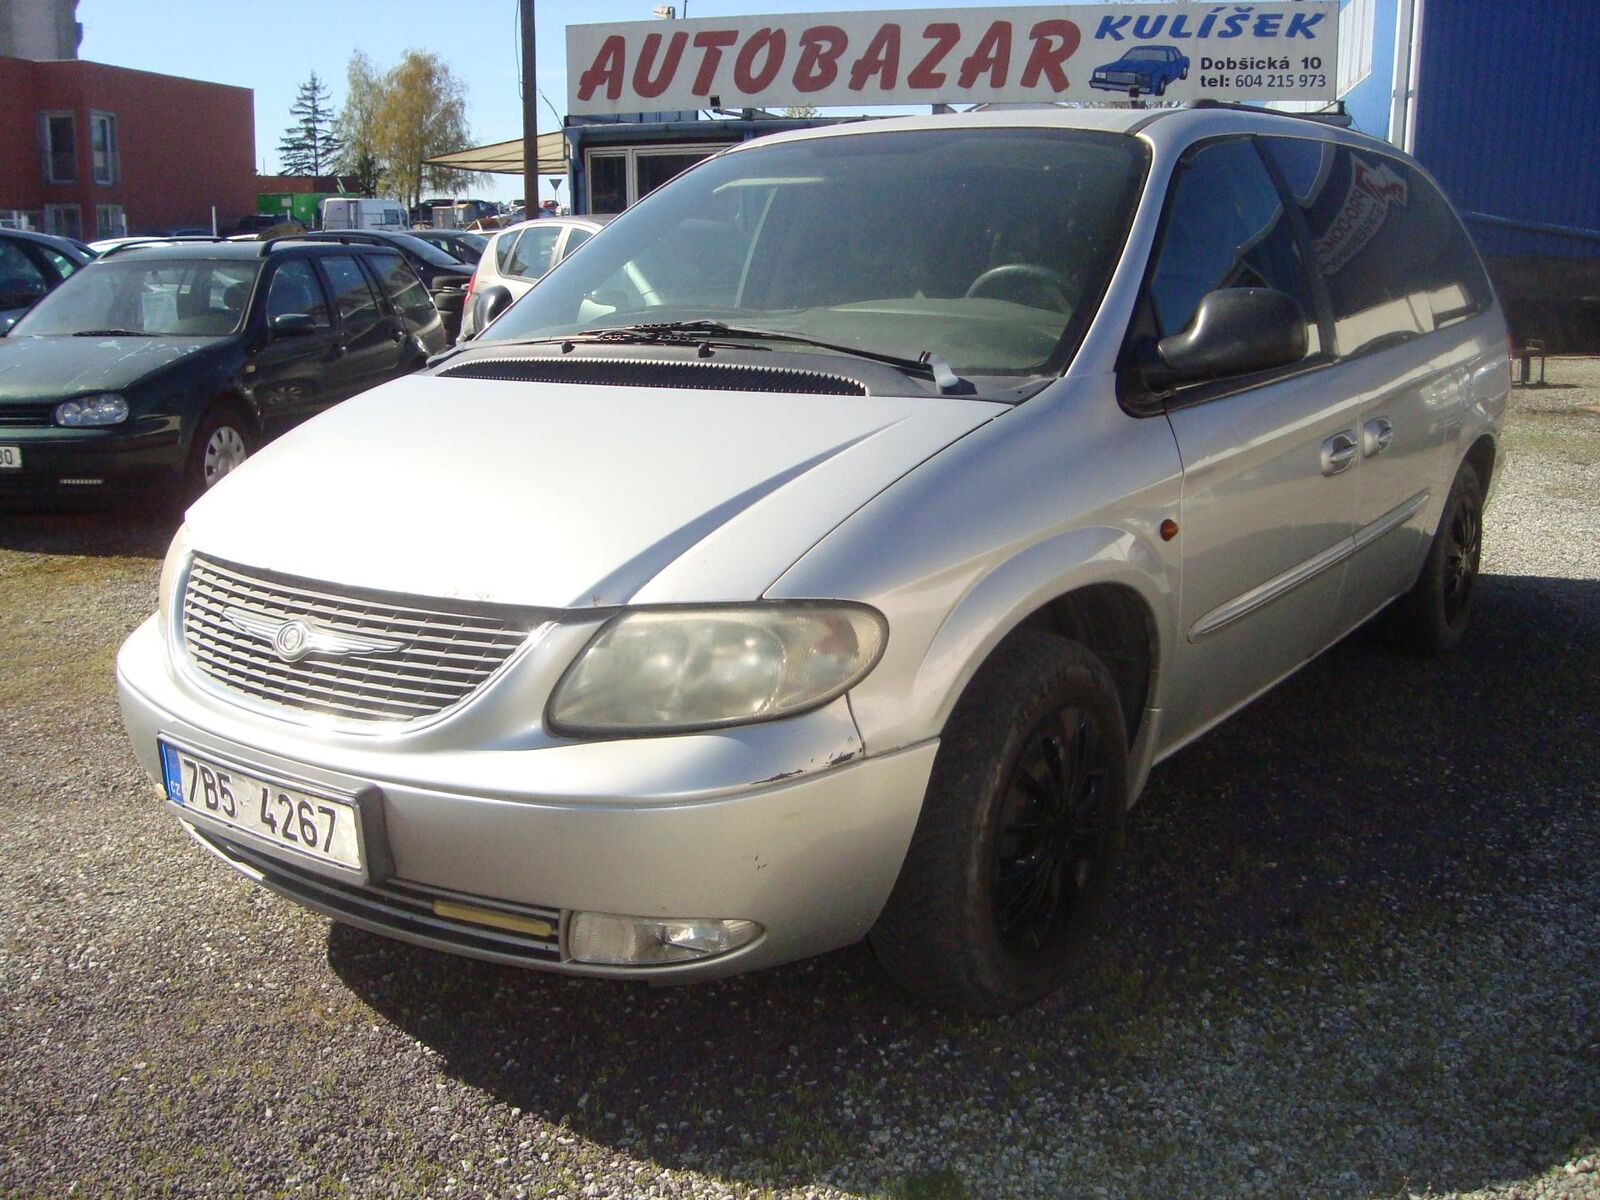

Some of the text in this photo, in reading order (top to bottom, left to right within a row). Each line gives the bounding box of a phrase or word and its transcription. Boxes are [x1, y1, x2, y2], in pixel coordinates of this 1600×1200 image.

[1094, 6, 1325, 41] KULÍŠEK
[576, 19, 1082, 101] AUTOBAZAR
[1200, 56, 1322, 71] Dobšická 10
[1200, 73, 1327, 88] tel: 604 215 973
[170, 780, 182, 797] CZ
[183, 757, 337, 853] 7B5 4267
